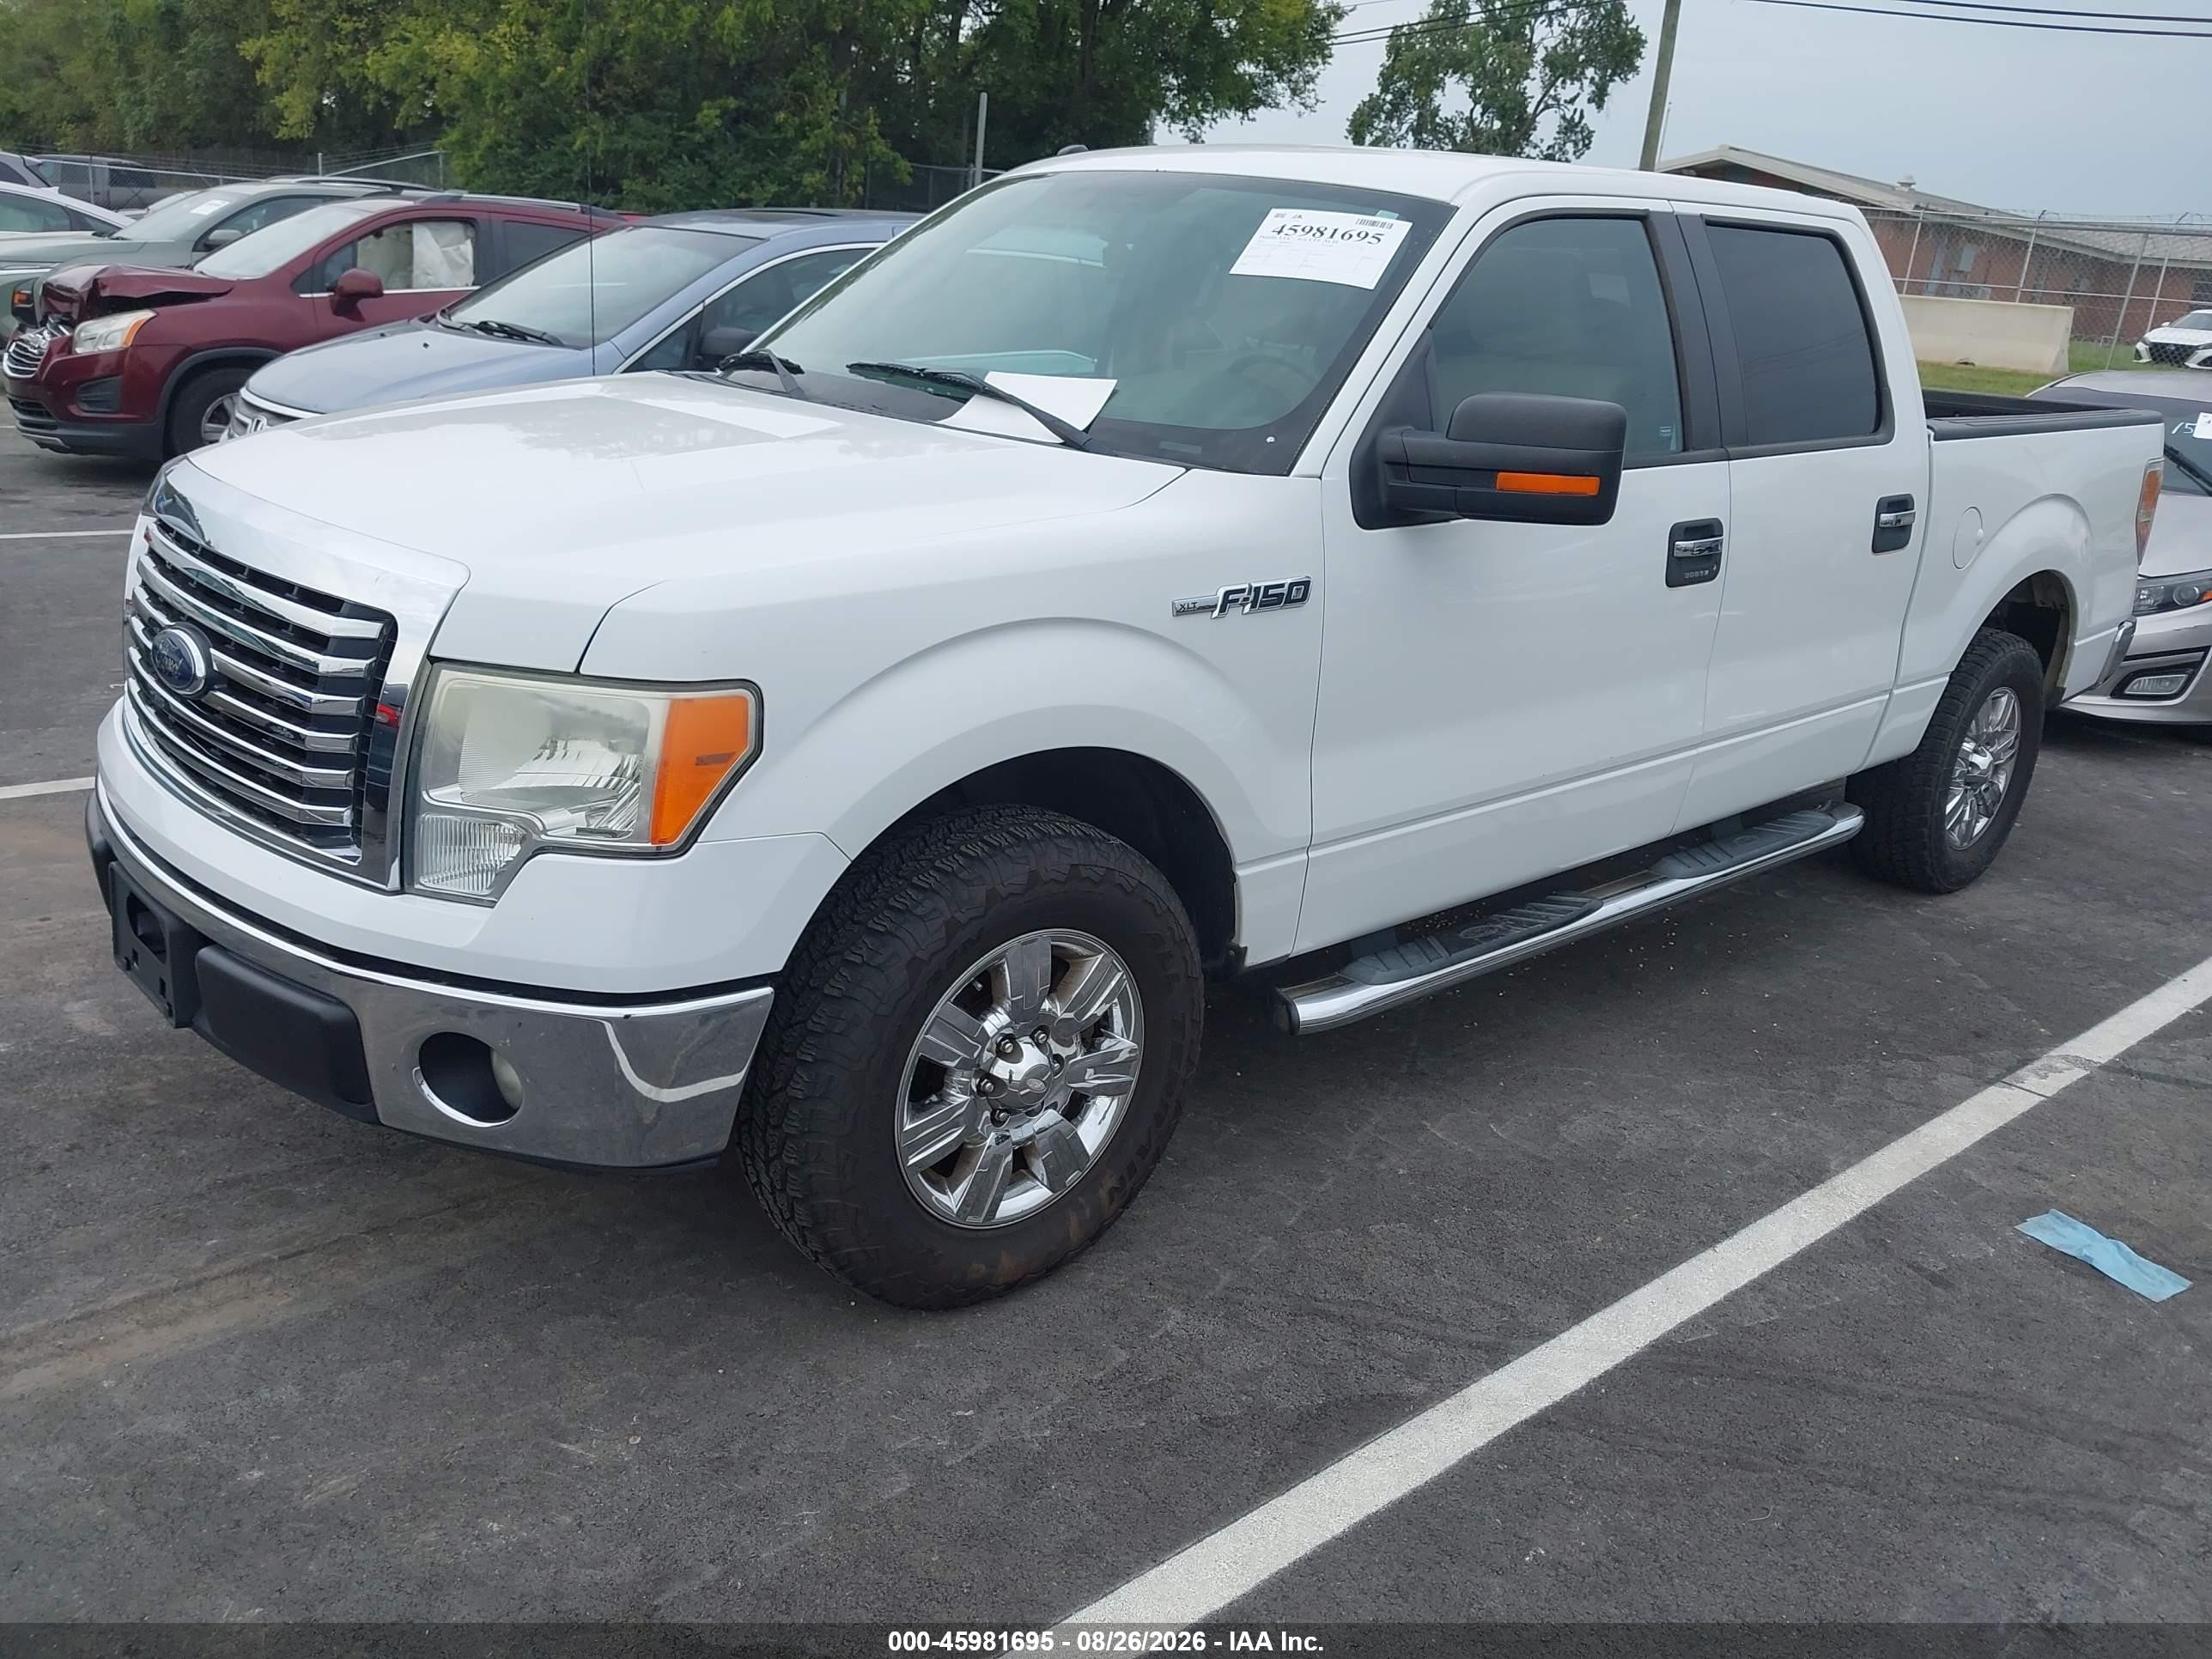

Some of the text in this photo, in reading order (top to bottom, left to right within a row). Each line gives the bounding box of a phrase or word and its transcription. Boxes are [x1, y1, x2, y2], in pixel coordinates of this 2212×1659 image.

[1271, 223, 1384, 246] 45981695
[1178, 576, 1312, 617] XLT F-150
